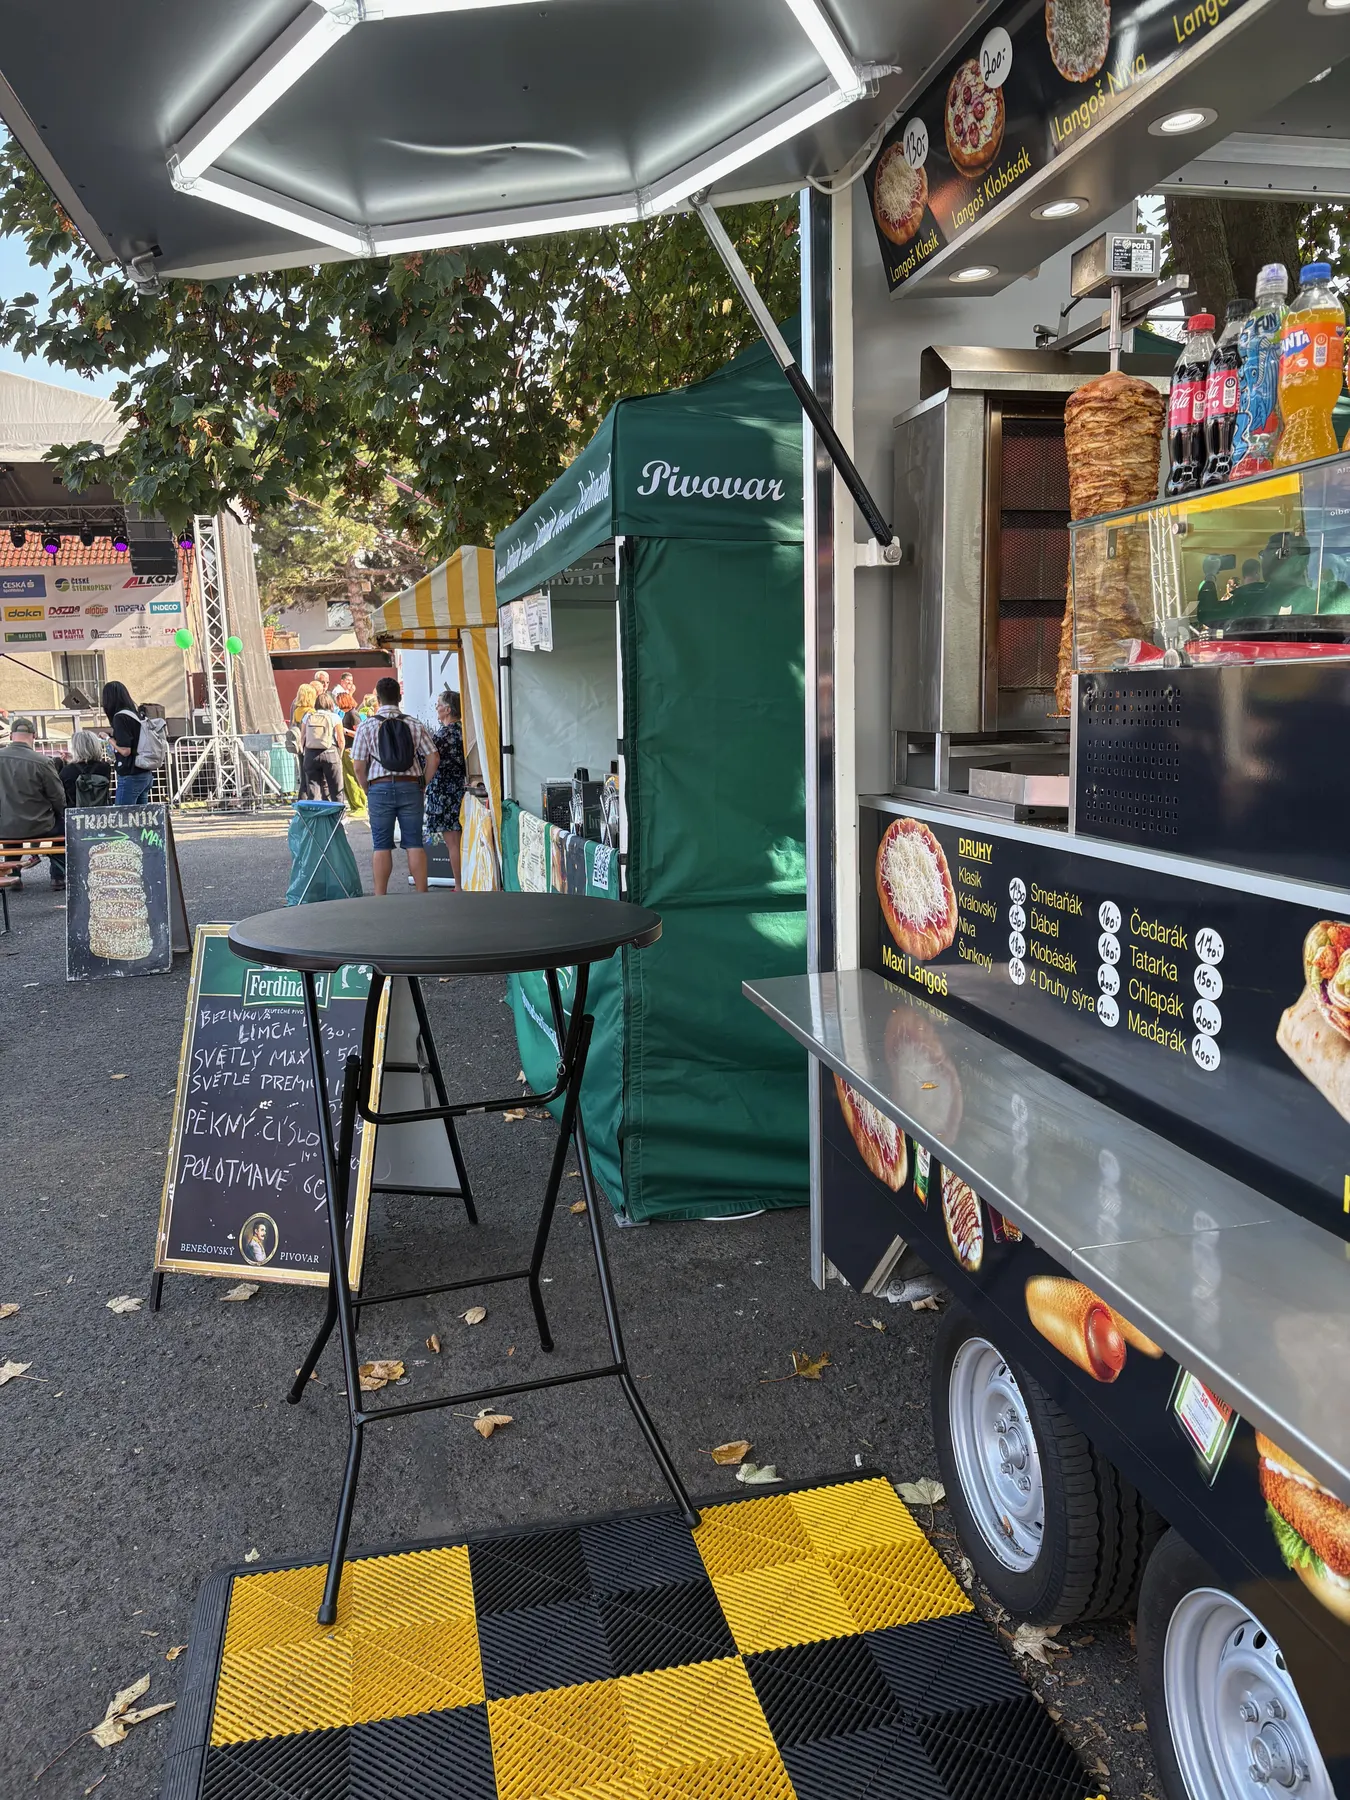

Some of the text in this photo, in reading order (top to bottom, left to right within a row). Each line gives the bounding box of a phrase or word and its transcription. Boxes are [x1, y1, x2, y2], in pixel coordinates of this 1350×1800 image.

[1054, 53, 1148, 142] Langoš Niva
[952, 146, 1032, 229] Langoš Klobásák
[889, 228, 940, 283] Langoš Klasik
[1256, 313, 1278, 334] FUN
[637, 460, 786, 501] Pivovar
[2, 580, 27, 589] ČESKÁ
[8, 609, 42, 618] doka
[959, 838, 993, 861] DRUHY
[959, 866, 982, 888] Klasik
[959, 891, 998, 923] Královský
[1030, 882, 1083, 917] Smetaňák
[959, 916, 976, 938] Niva
[1030, 907, 1059, 938] Ďábel
[1130, 907, 1188, 950] Čedarák
[882, 944, 948, 997] Maxi Langoš
[959, 938, 993, 974] Šunkový
[1030, 939, 1078, 976] Klobásák
[1129, 944, 1178, 982] Tatarka
[249, 975, 325, 998] Ferdinad
[1030, 968, 1095, 1013] 4 Druhy sýra
[1128, 977, 1185, 1020] Chlapák
[1127, 1009, 1187, 1055] Maďarák
[180, 1242, 319, 1264] BENEŠOVSKÝ PIVOVAR
